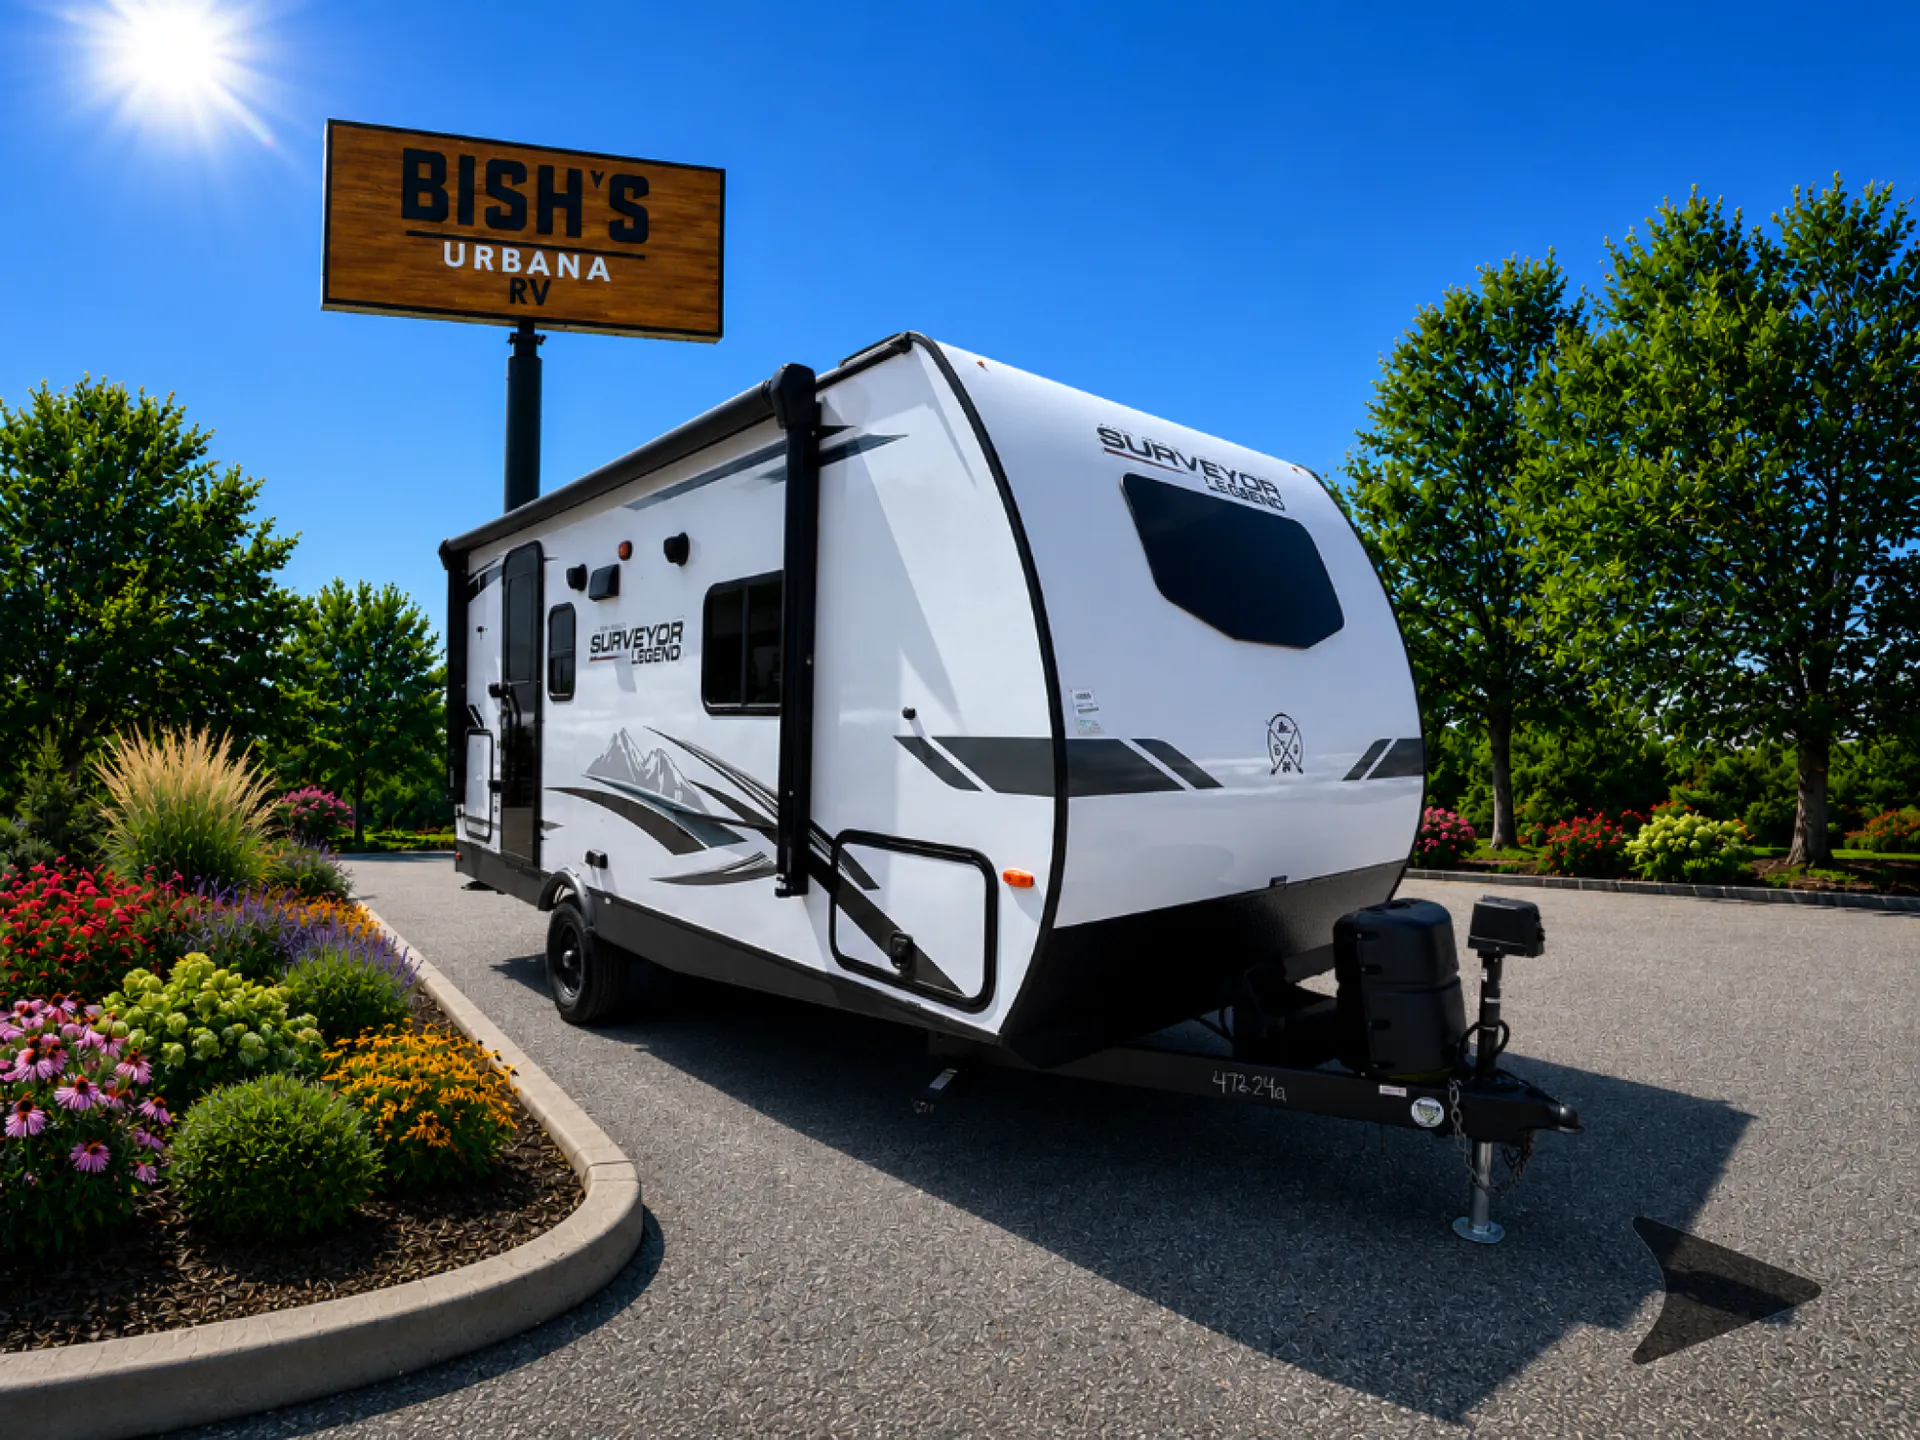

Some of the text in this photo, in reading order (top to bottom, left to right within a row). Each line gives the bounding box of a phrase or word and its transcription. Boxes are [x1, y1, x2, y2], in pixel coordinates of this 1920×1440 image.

[401, 147, 649, 244] BISH'S
[443, 241, 611, 282] URBANA
[509, 277, 551, 305] RV
[1097, 425, 1282, 499] SURVEYOR
[1203, 475, 1286, 511] LEGEND
[590, 621, 683, 653] SURVEYOR
[631, 644, 681, 664] LEGEND
